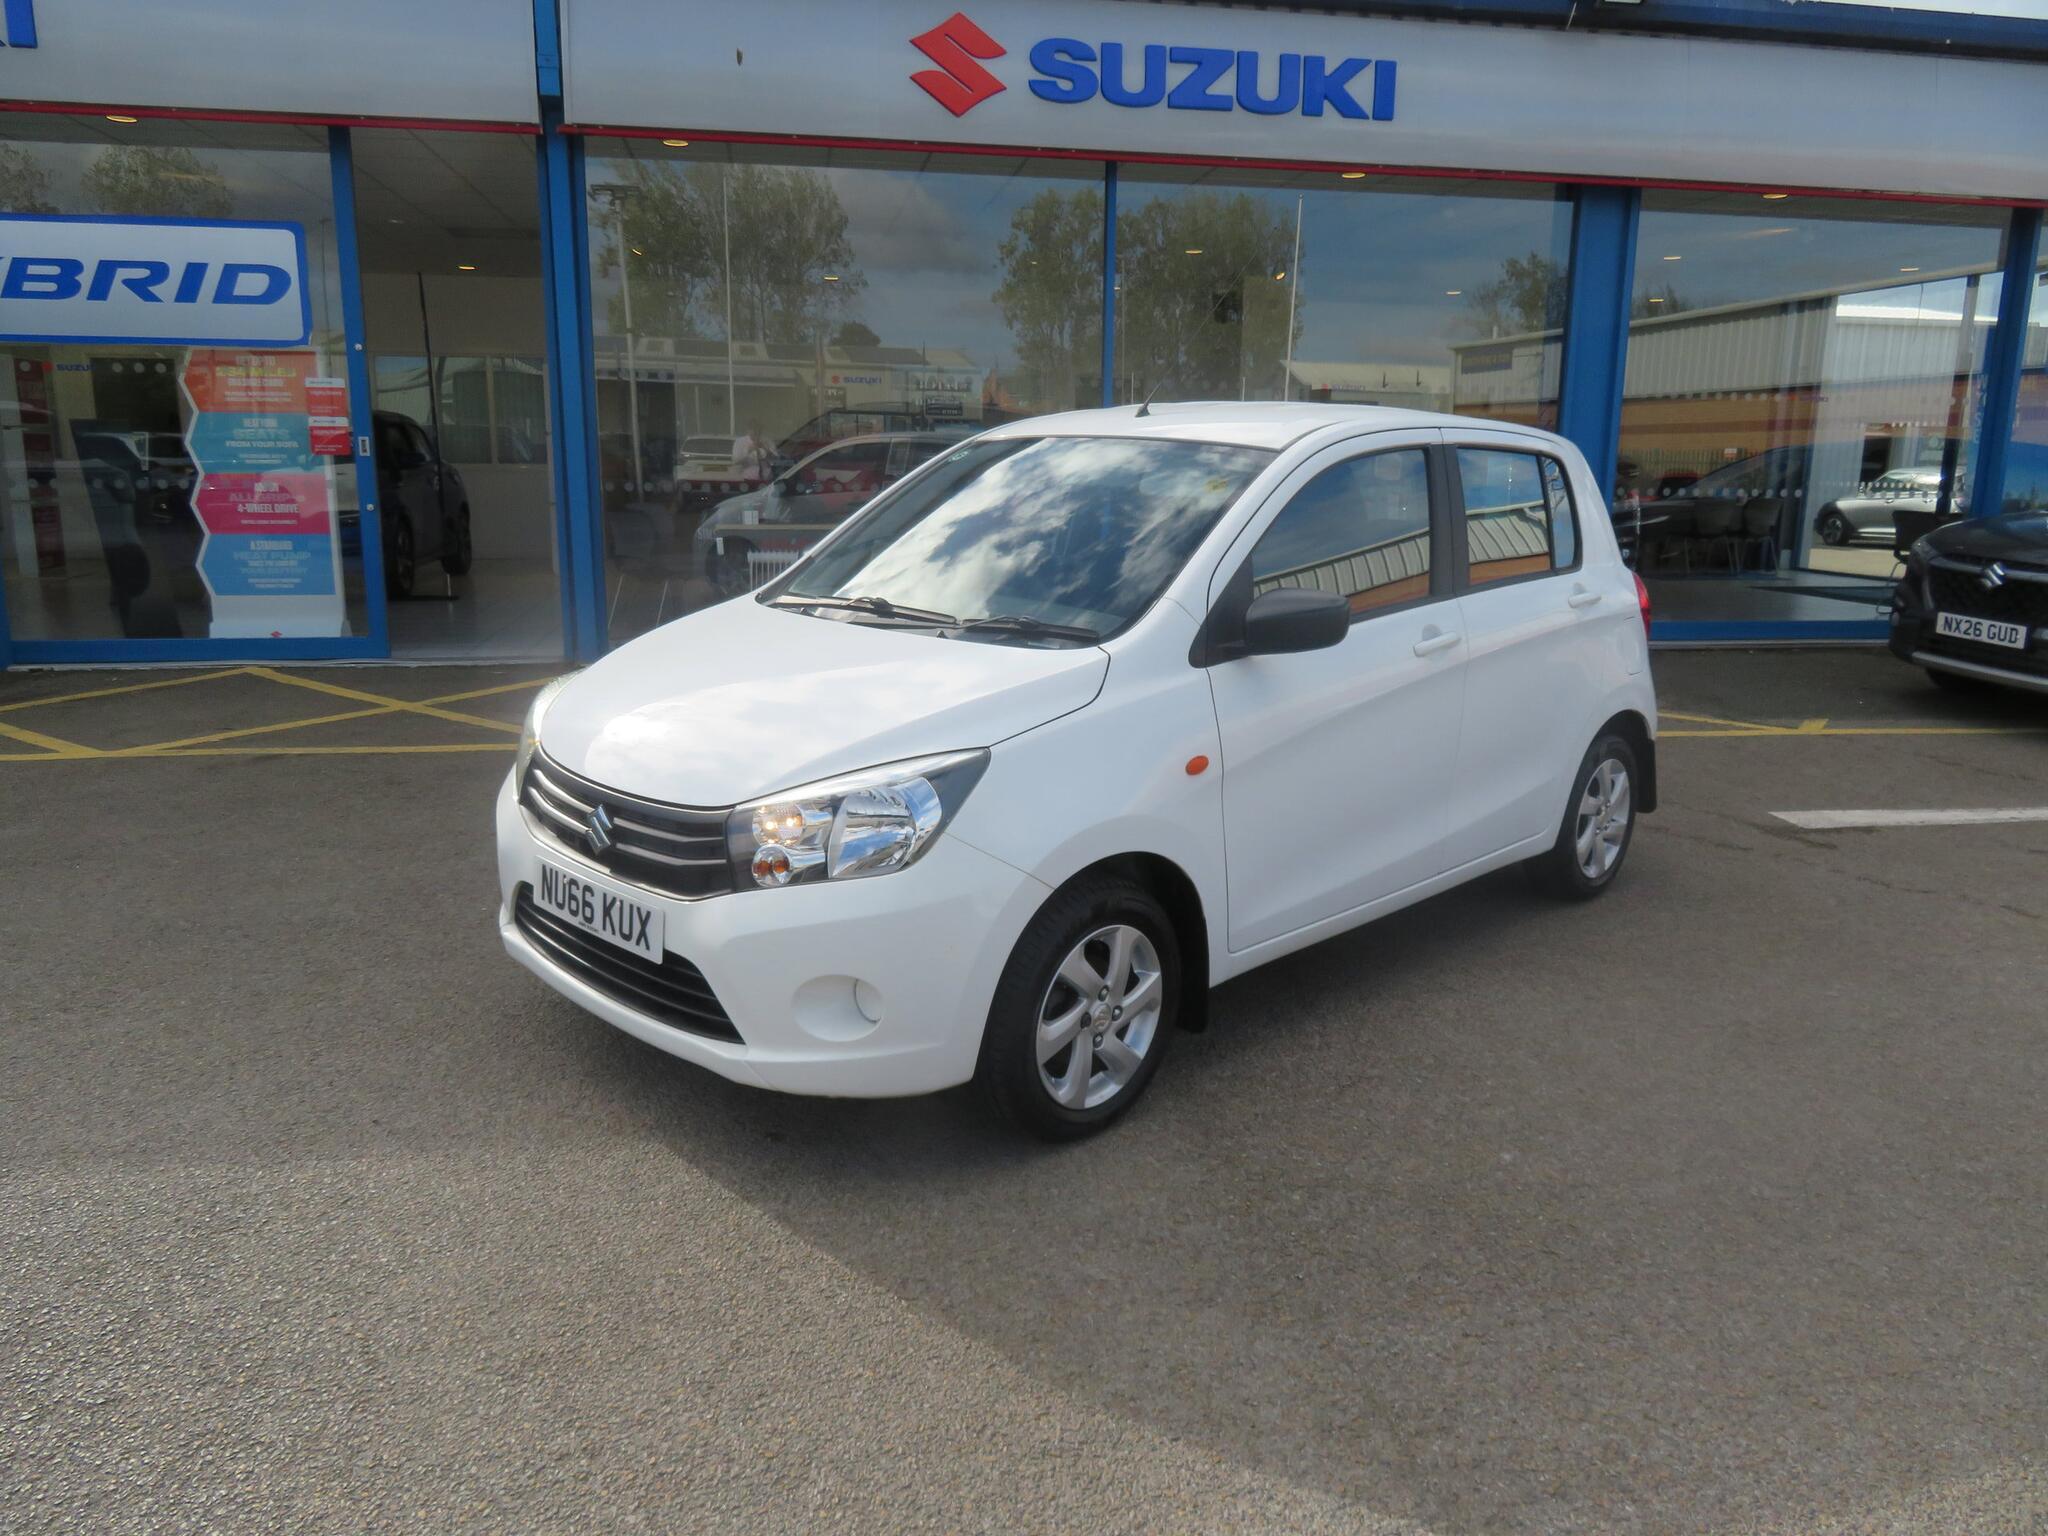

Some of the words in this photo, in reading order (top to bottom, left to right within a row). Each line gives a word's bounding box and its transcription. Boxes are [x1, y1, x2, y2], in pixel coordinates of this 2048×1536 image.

[1028, 37, 1397, 121] SUZUKI
[0, 256, 291, 305] BRID
[843, 375, 882, 384] SUZUKI
[1943, 615, 1983, 637] NX26
[1987, 624, 2019, 644] GUD
[541, 863, 595, 925] NU66
[602, 892, 652, 951] KUX
